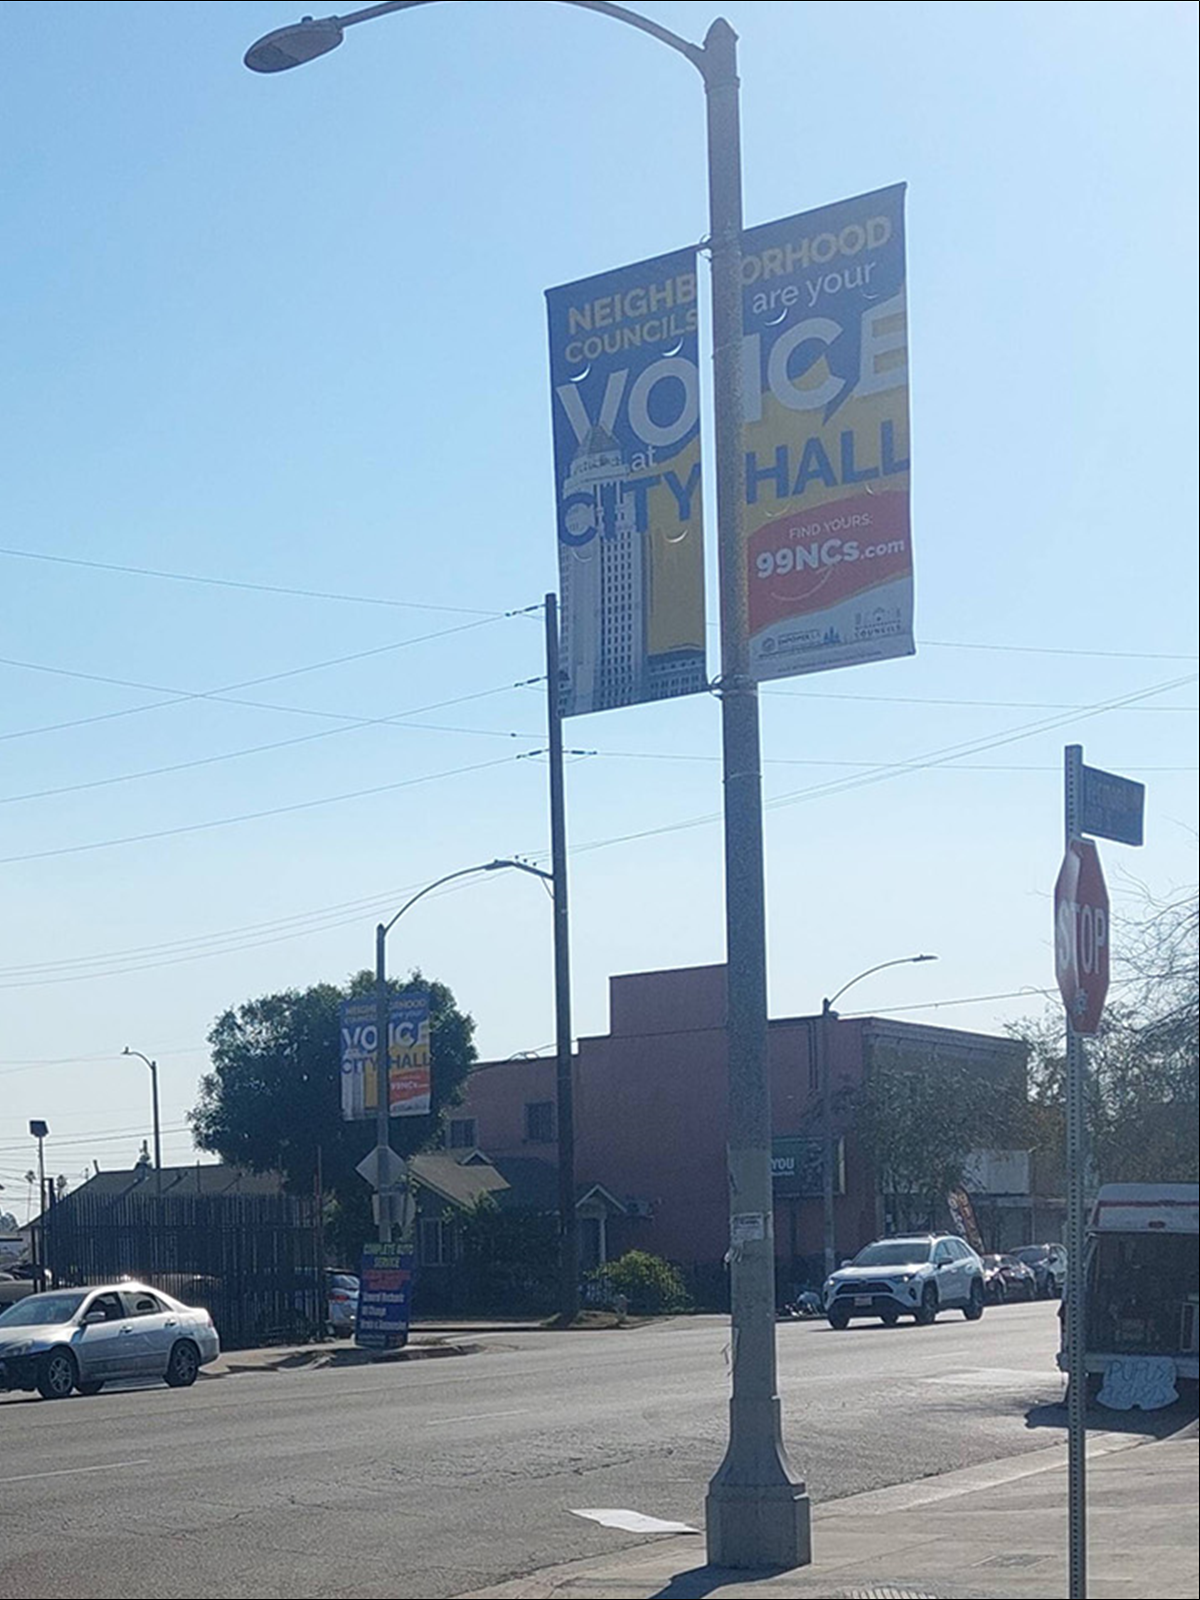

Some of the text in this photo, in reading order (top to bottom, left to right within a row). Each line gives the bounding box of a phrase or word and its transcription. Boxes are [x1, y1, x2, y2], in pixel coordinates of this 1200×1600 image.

[752, 260, 876, 314] are your
[565, 307, 698, 363] COUNCILS
[632, 446, 656, 473] at
[558, 420, 910, 547] CITY HALL
[789, 523, 820, 540] FIND
[756, 537, 905, 578] 99NCs.com
[1058, 899, 1106, 975] STOP
[342, 1052, 431, 1074] CITY HALL
